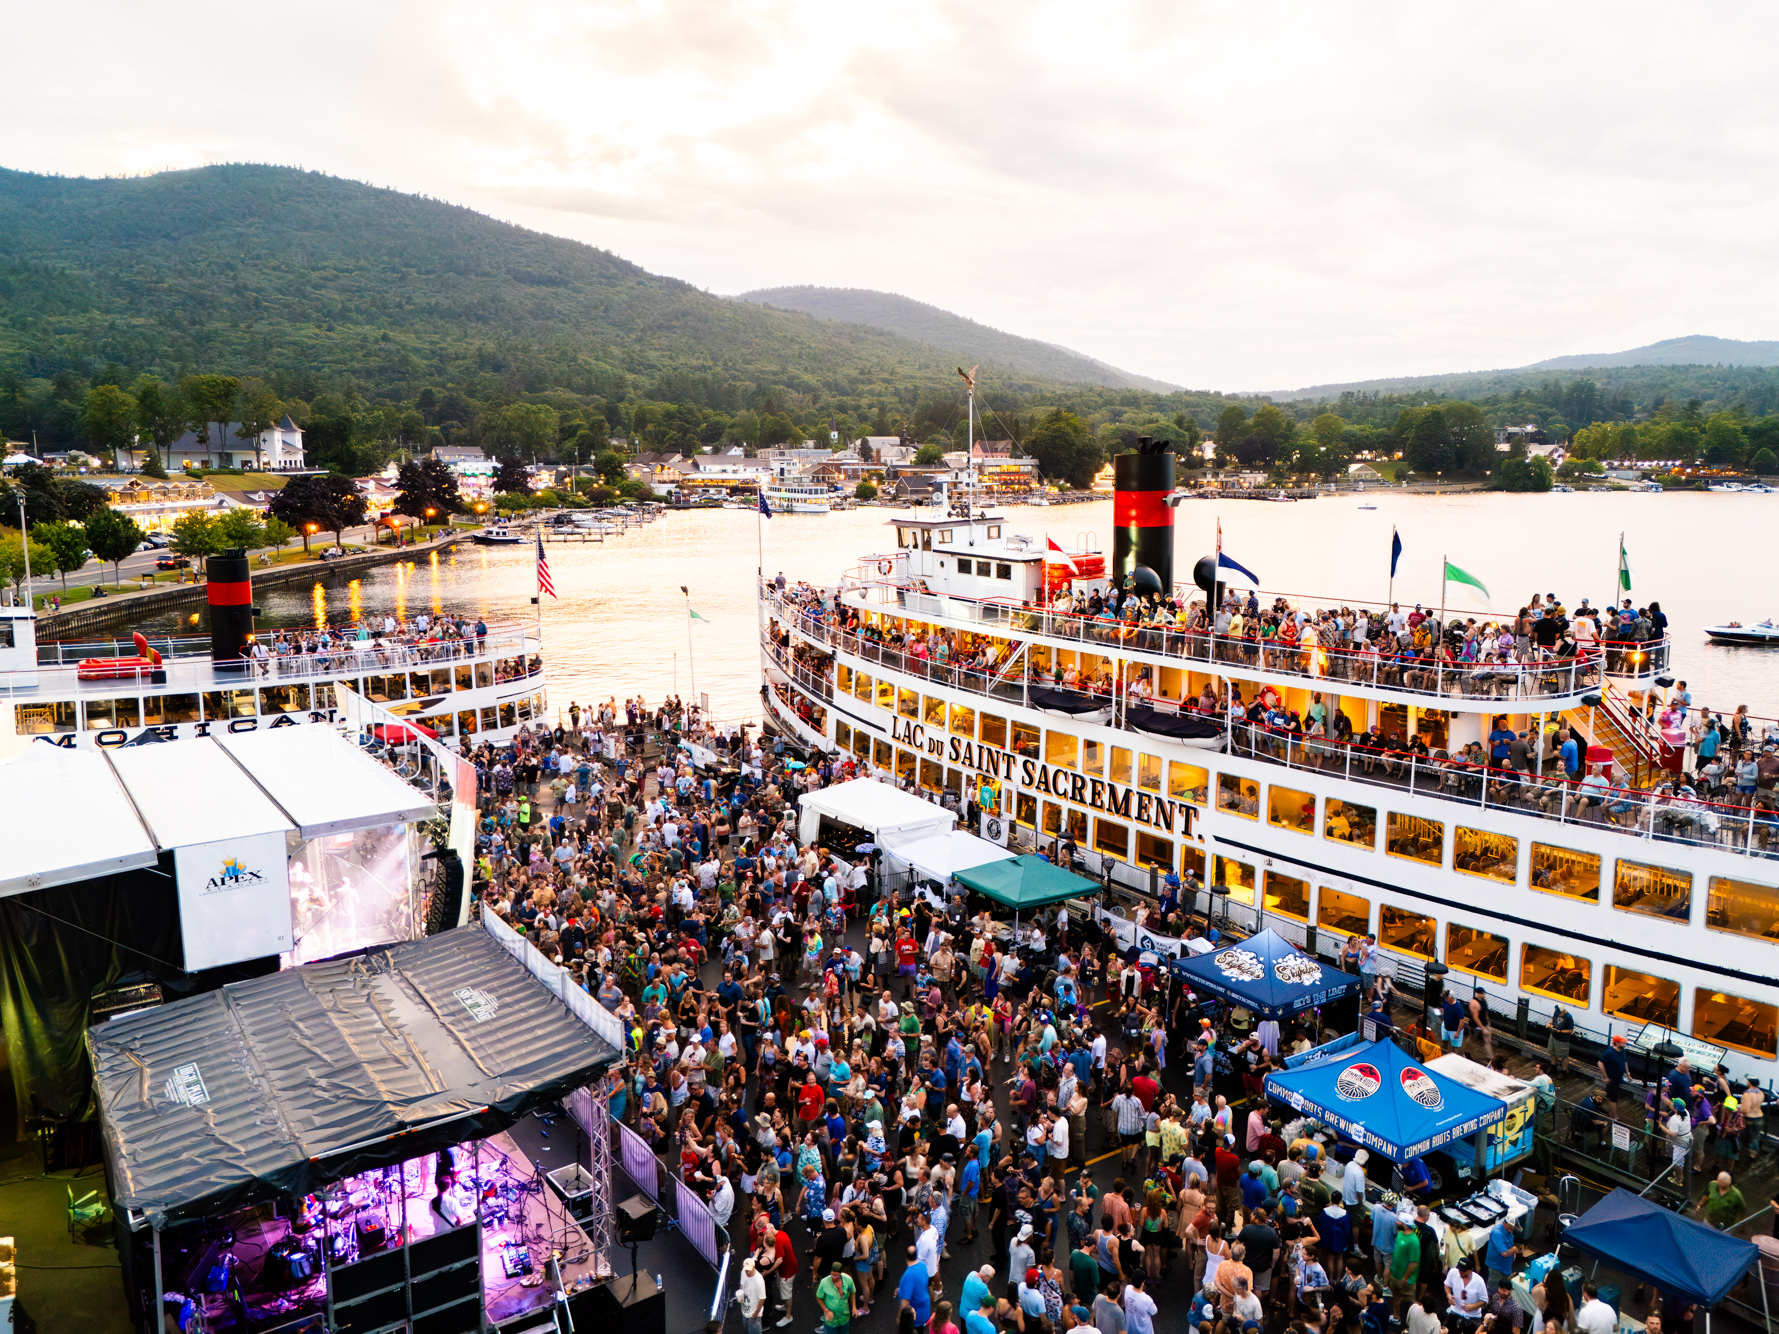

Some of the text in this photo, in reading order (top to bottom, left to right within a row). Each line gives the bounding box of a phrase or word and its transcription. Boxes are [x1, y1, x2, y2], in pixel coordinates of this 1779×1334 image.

[891, 716, 924, 751] LAC
[928, 737, 945, 759] DU
[949, 736, 1017, 782] SAINT
[1021, 759, 1205, 844] SACREMENT.
[205, 869, 264, 890] APEX
[1328, 984, 1347, 997] LIMIT
[1267, 1080, 1293, 1102] COMMO
[1324, 1110, 1353, 1135] BREWIN
[1404, 1139, 1430, 1160] COMMON
[1431, 1132, 1451, 1148] ROOTS
[1452, 1118, 1478, 1140] BREWING
[1479, 1106, 1505, 1127] COMPANY
